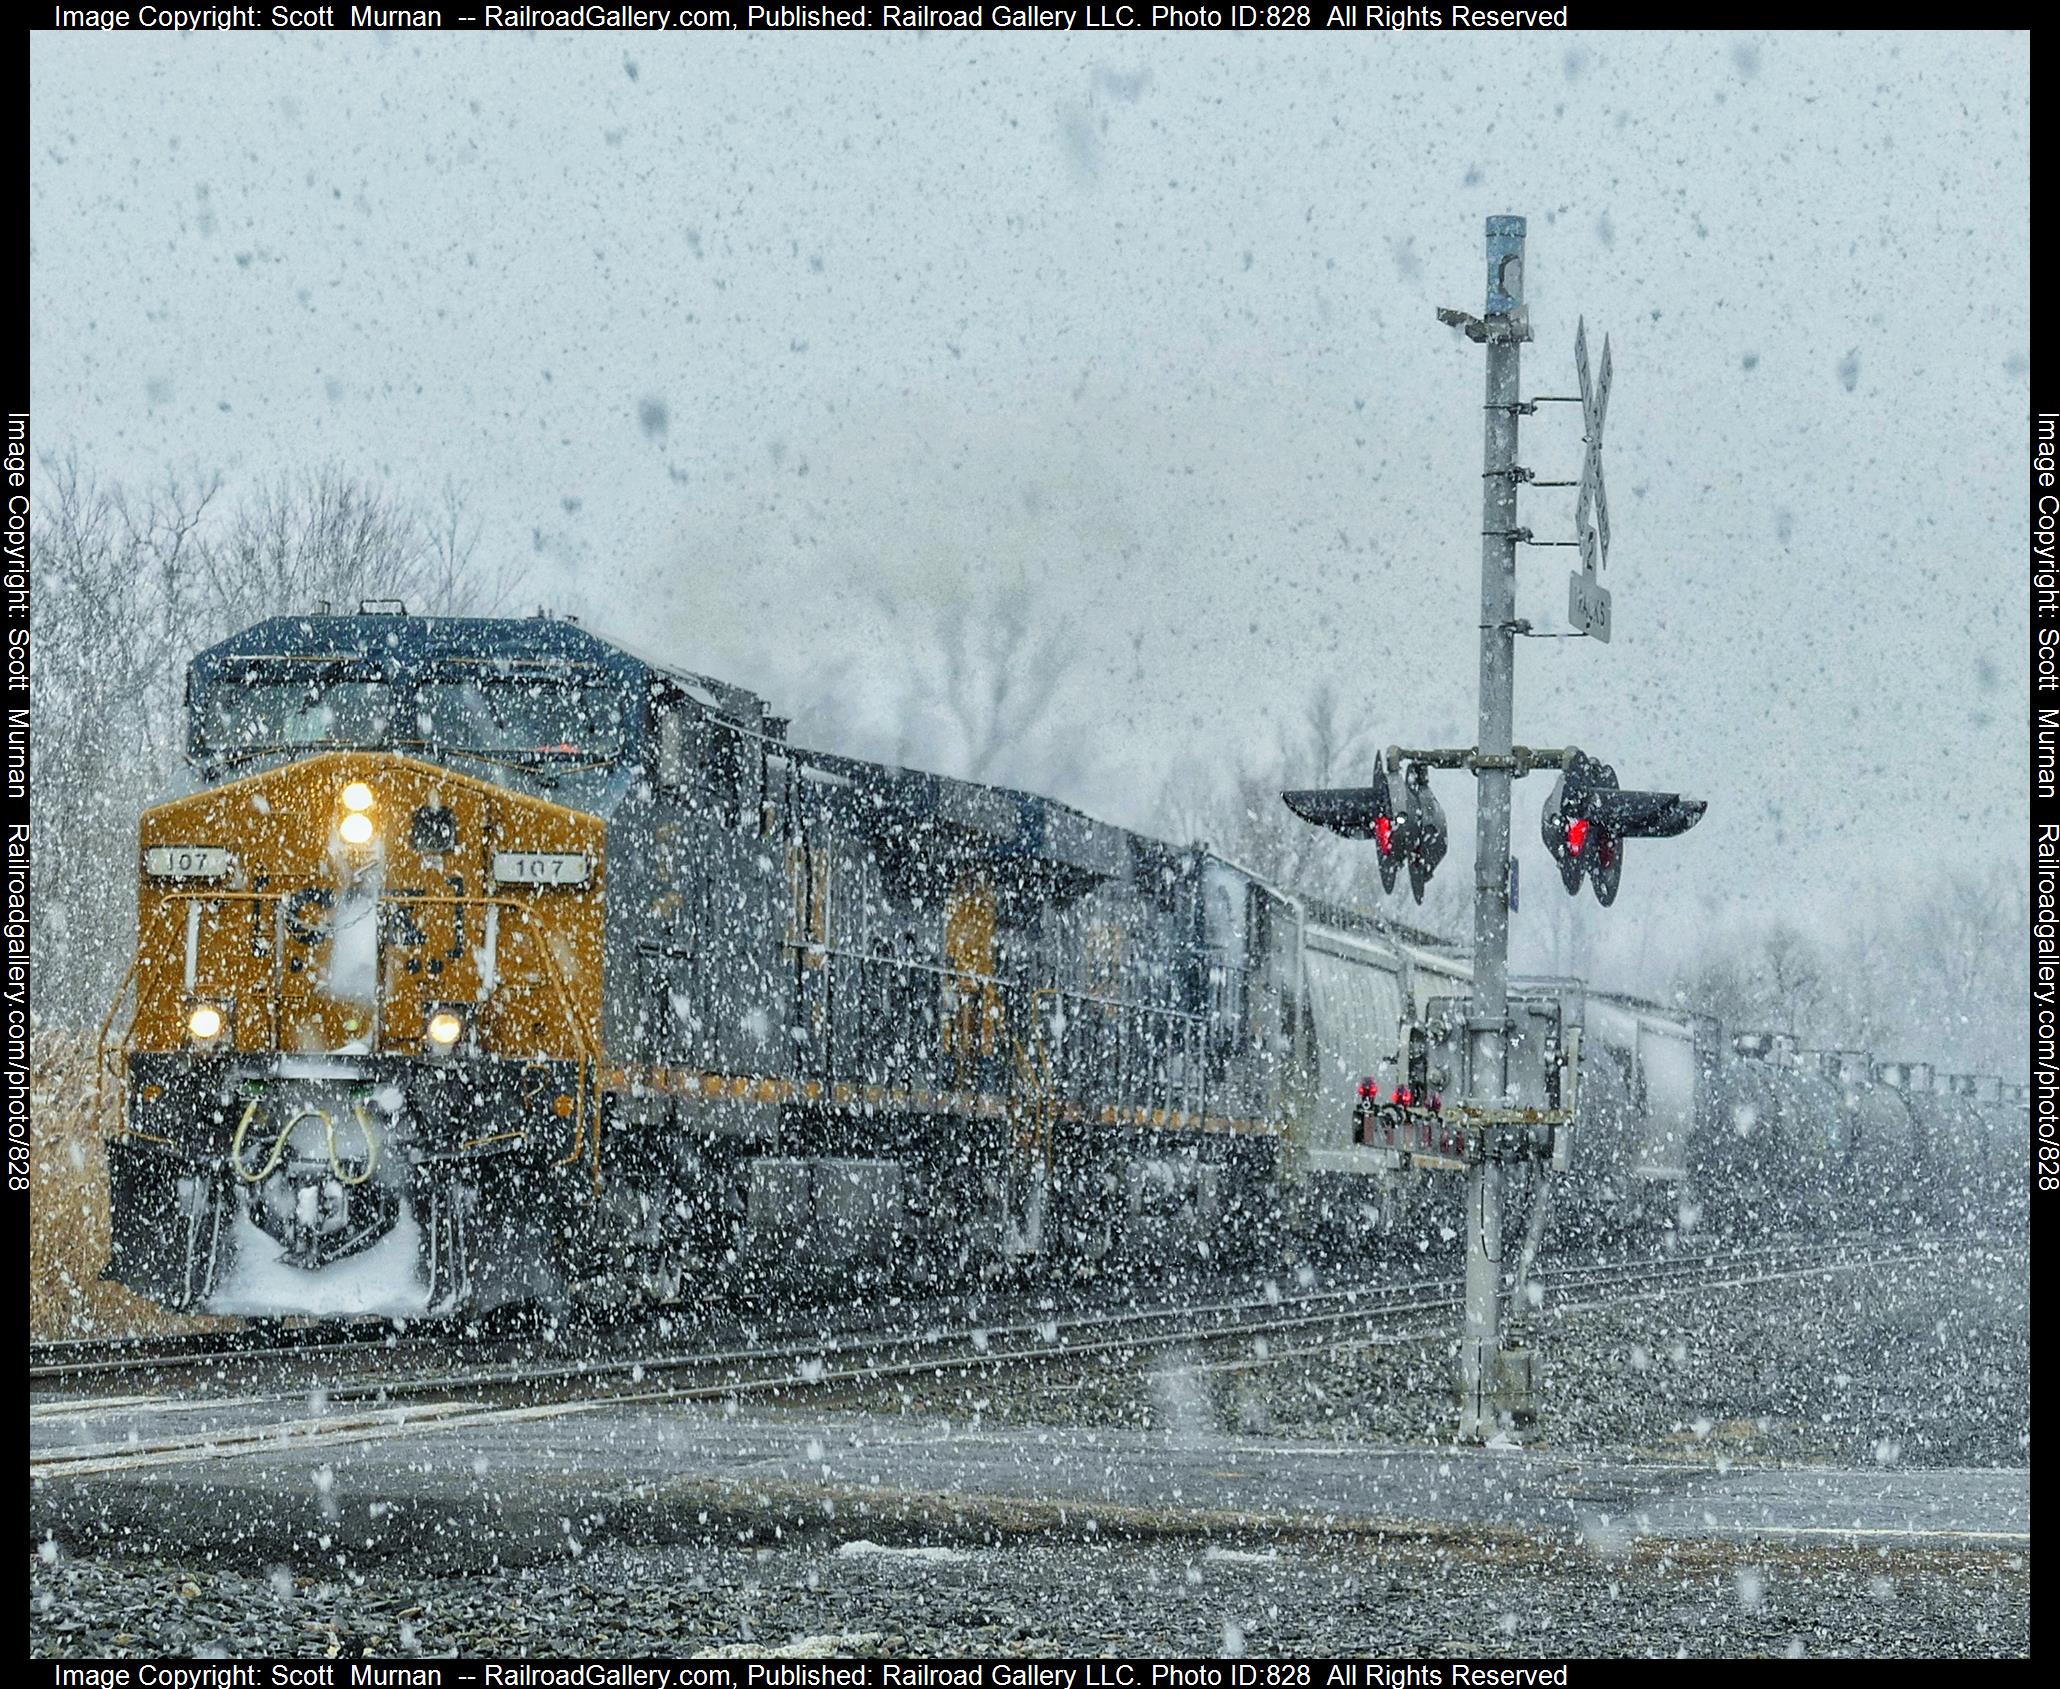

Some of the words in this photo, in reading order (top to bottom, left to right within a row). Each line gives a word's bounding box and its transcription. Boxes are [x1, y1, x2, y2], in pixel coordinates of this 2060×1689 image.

[1586, 531, 1595, 572] 2
[167, 853, 208, 871] 107
[516, 859, 564, 878] 107
